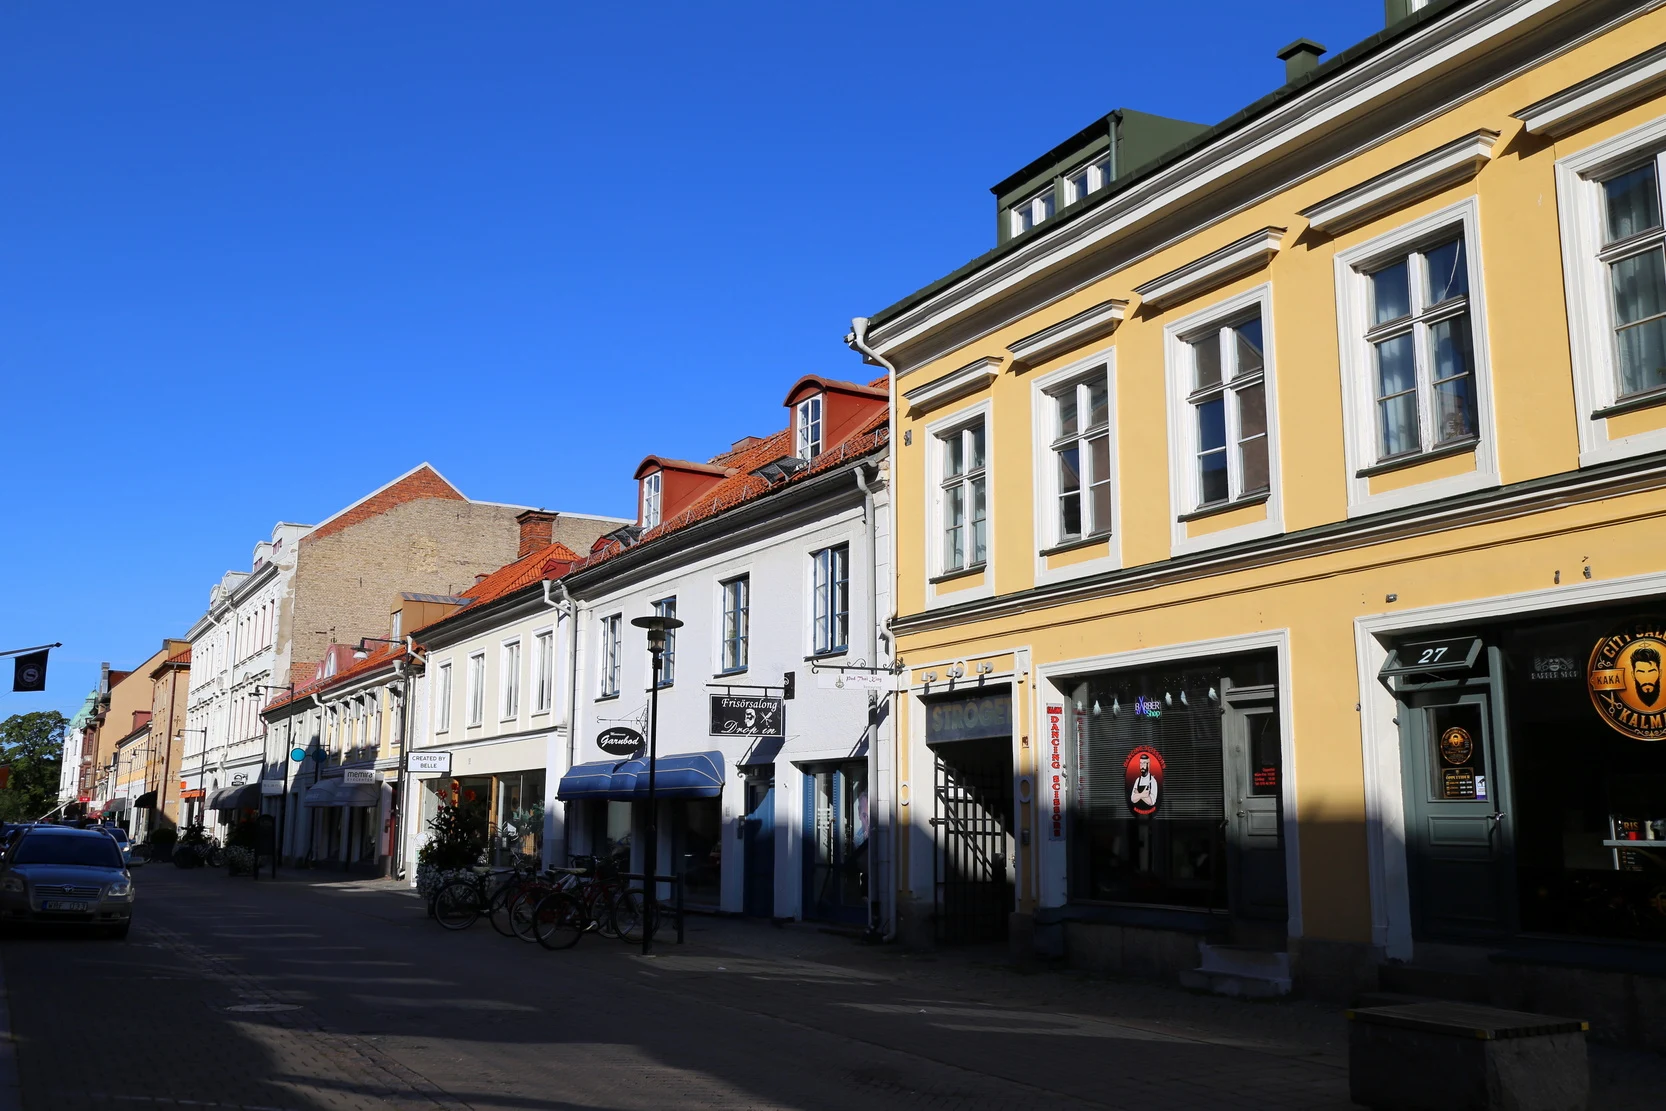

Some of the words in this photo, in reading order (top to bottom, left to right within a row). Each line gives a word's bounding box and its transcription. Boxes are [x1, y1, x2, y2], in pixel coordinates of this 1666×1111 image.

[1602, 631, 1632, 659] CITY
[1417, 646, 1449, 664] 27
[721, 698, 778, 713] Frisörsalong
[1135, 699, 1160, 711] BARBER
[1147, 709, 1160, 718] Shop
[932, 697, 1012, 732] STRÖGET
[1618, 707, 1666, 730] KALM
[720, 719, 759, 737] Drop
[761, 725, 777, 735] in
[600, 734, 640, 748] Garnbod
[1050, 715, 1061, 769] DANCING
[1051, 775, 1062, 837] SCISSORS
